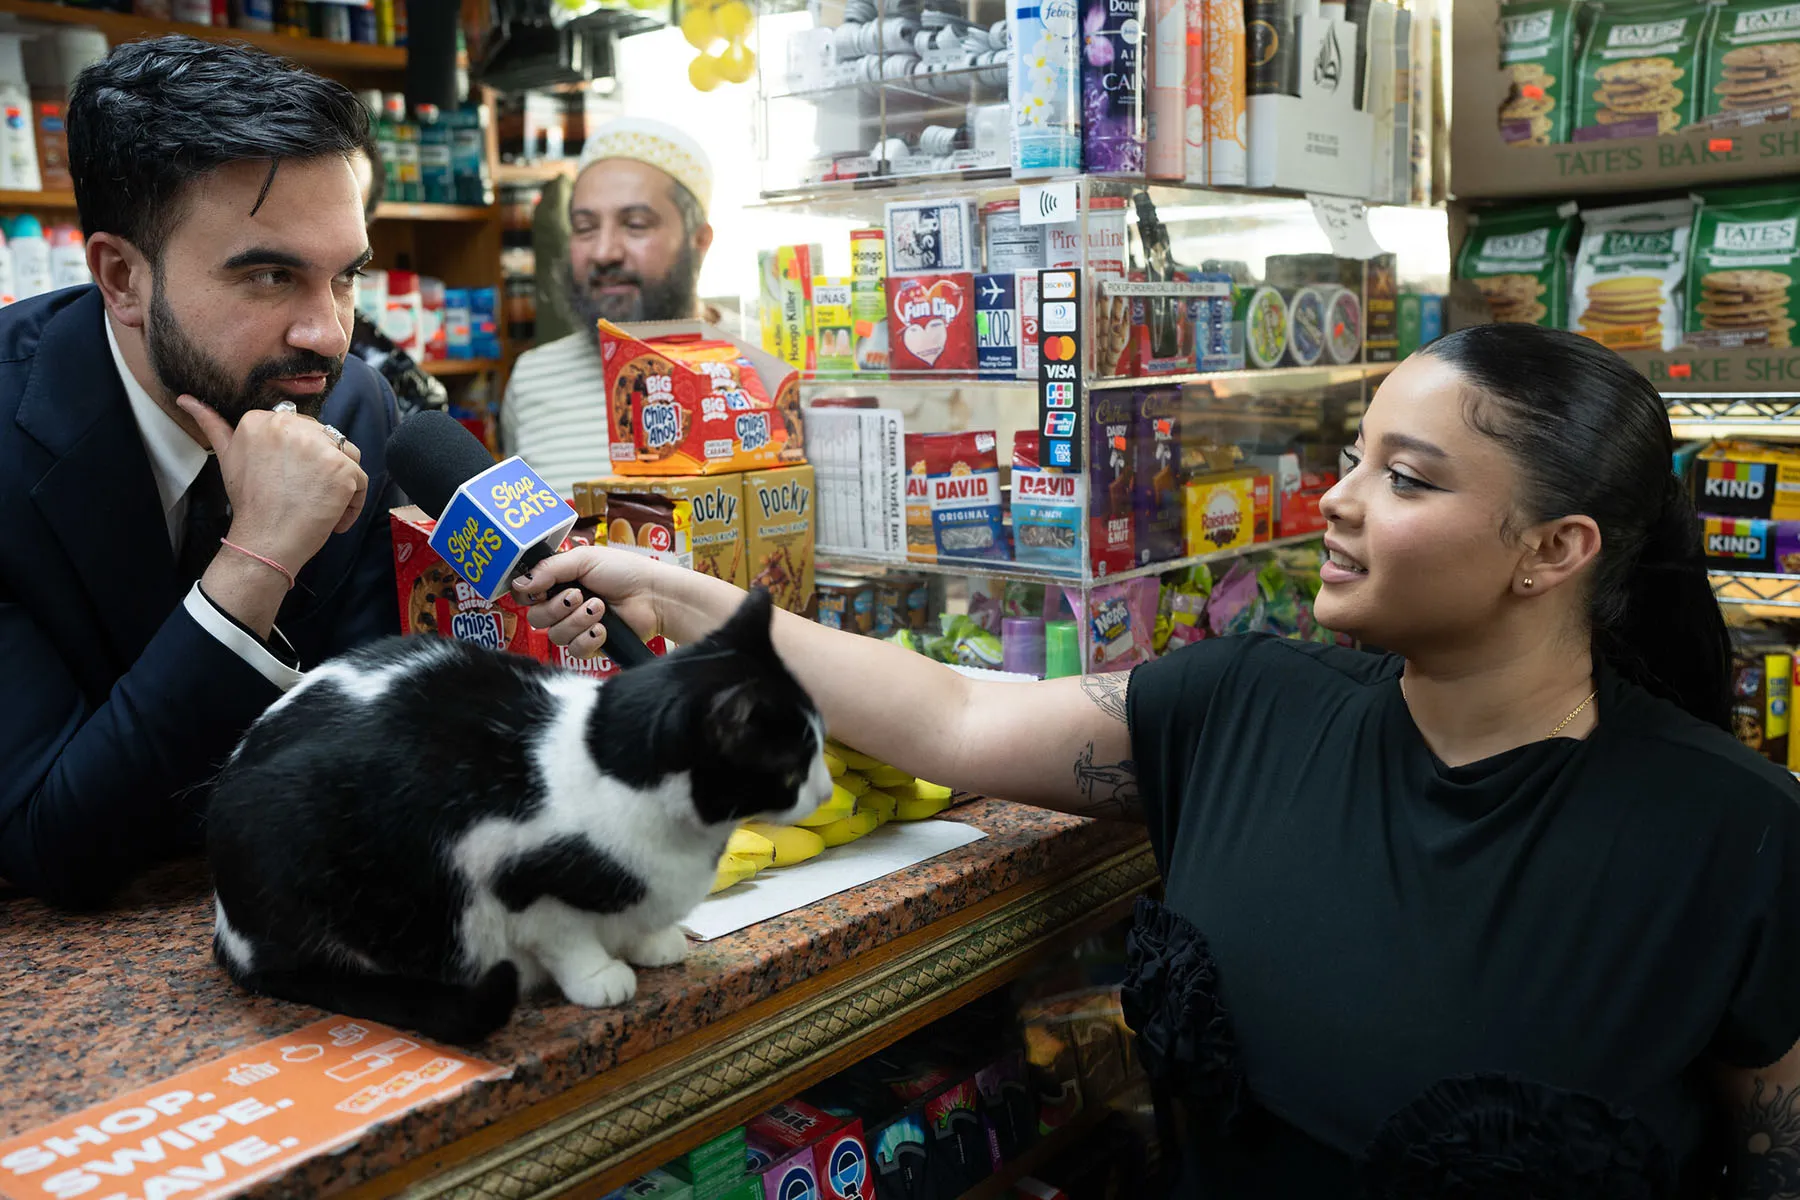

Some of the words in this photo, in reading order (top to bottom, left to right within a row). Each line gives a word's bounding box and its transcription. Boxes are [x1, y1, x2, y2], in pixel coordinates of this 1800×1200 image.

[1658, 137, 1744, 168] BAKE
[816, 292, 847, 304] UNAS
[1044, 364, 1076, 379] VISA
[888, 419, 898, 467] China
[491, 475, 535, 509] Shop
[936, 478, 988, 500] DAVID
[1020, 475, 1075, 497] DAVID
[1704, 478, 1765, 500] KIND
[503, 489, 558, 529] CATS
[693, 487, 738, 526] ocky
[939, 510, 989, 522] ORIGINAL
[447, 516, 479, 563] Shop
[692, 534, 714, 545] MOND
[1709, 535, 1761, 554] KIND
[463, 528, 502, 583] CATS
[453, 613, 495, 641] Chips
[0, 1089, 216, 1175] SHOP.
[42, 1097, 295, 1199] SWIPE.
[101, 1135, 300, 1200] AVE.
